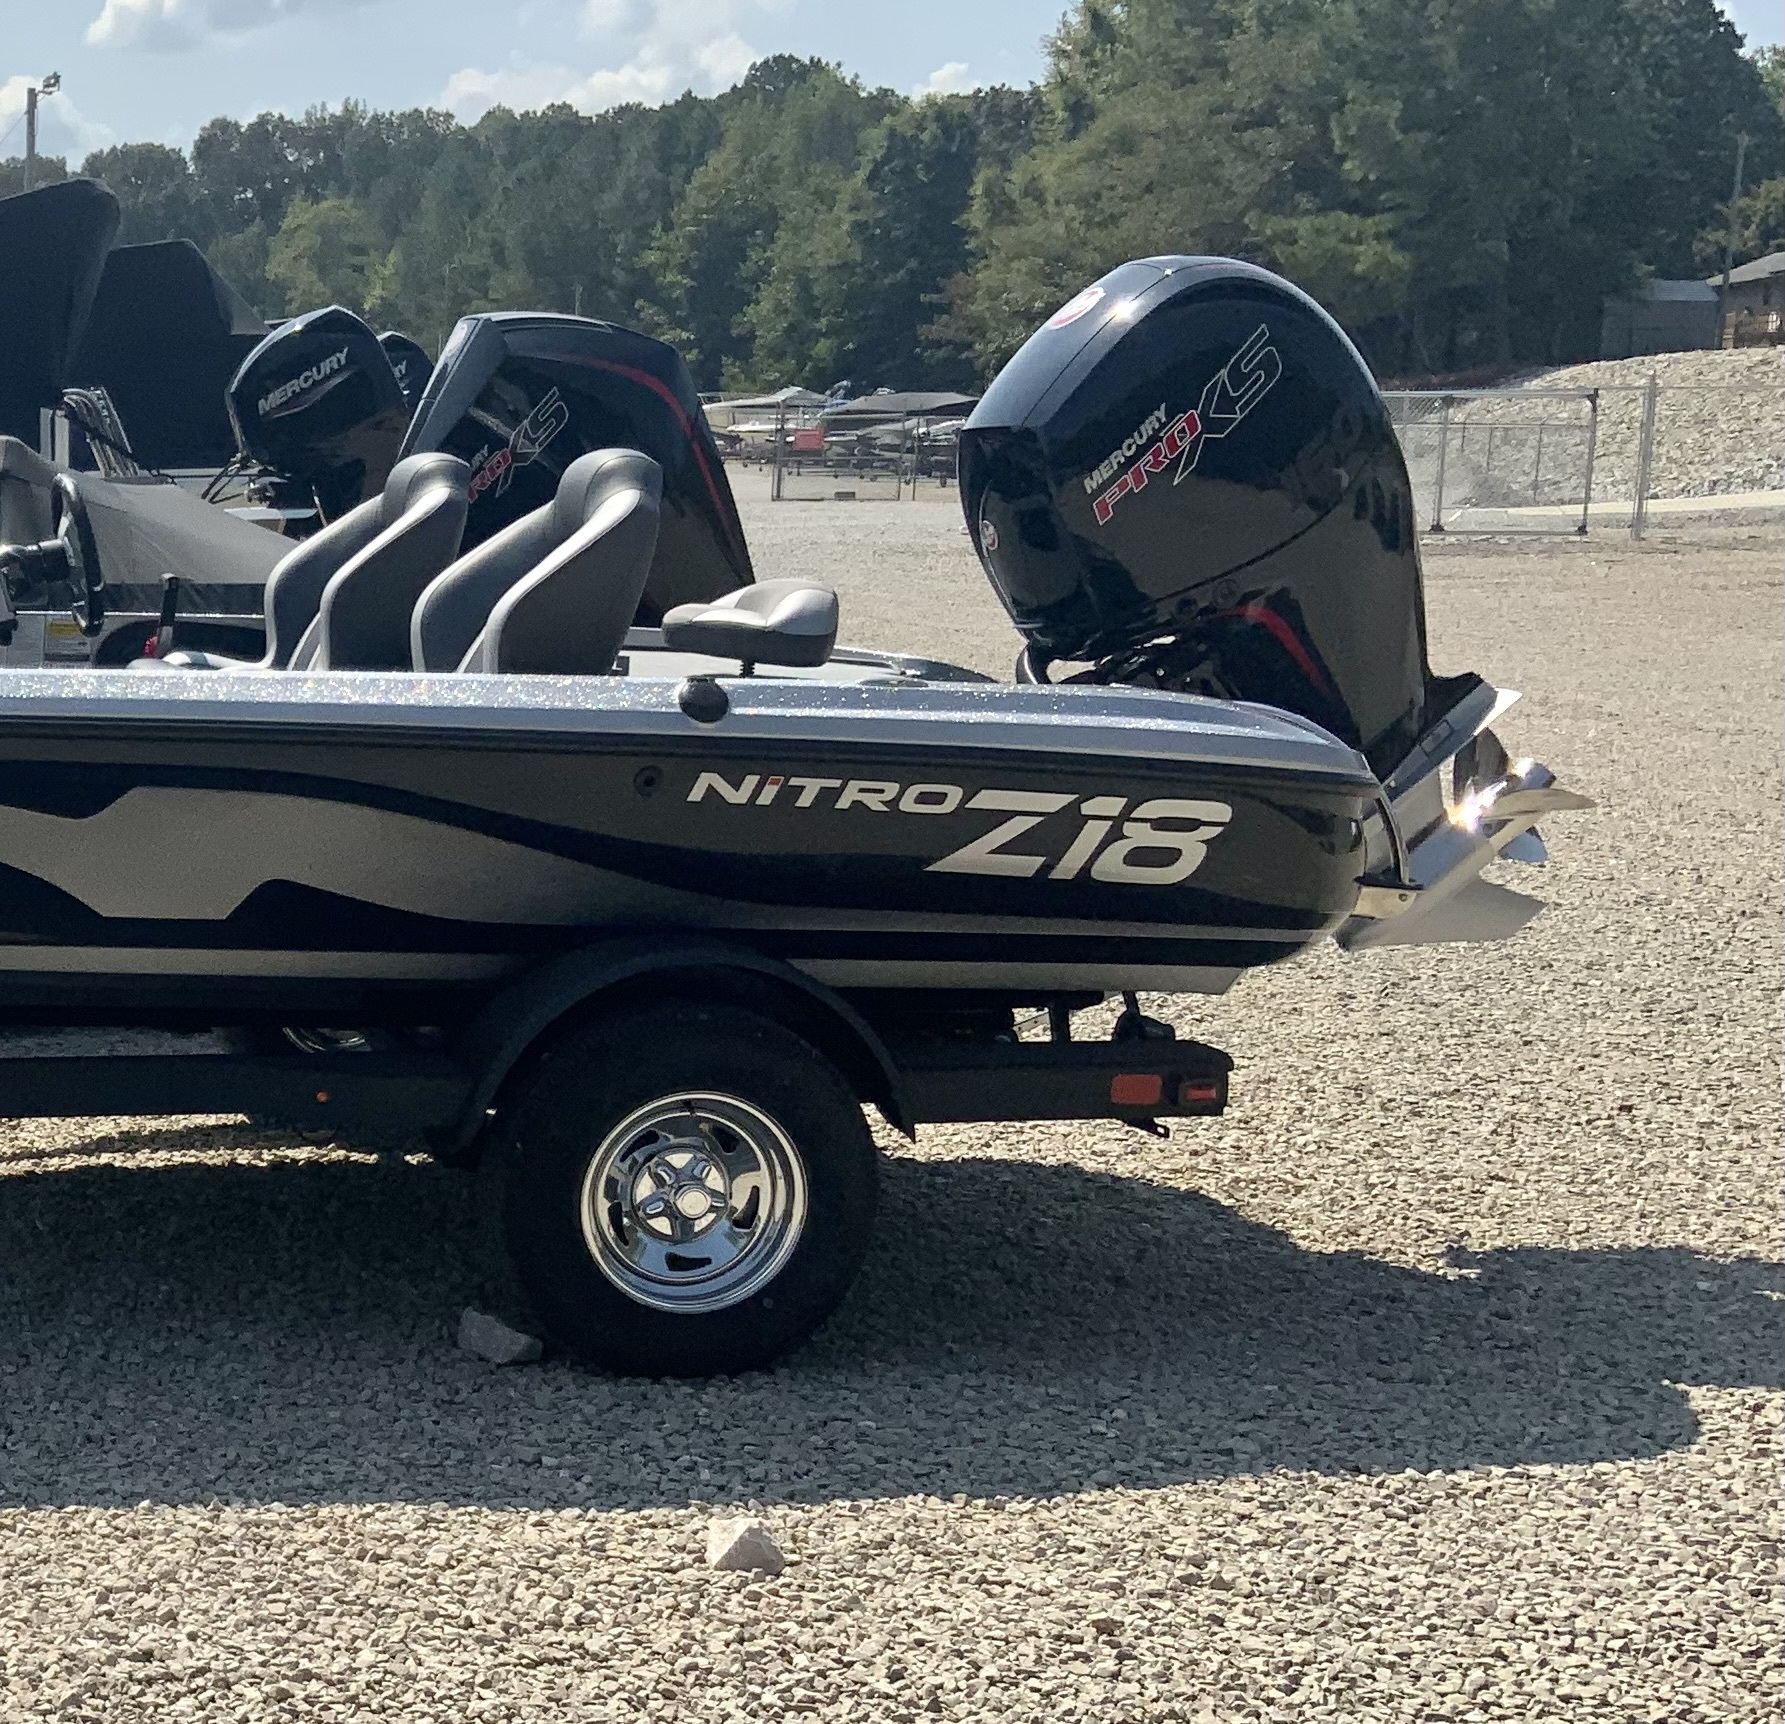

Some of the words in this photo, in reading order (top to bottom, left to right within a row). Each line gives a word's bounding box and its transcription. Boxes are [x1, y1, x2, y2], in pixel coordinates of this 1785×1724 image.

[258, 347, 349, 416] MERCURY
[1093, 409, 1202, 526] PRO
[1159, 323, 1282, 486] XS
[468, 448, 511, 504] RO
[1083, 402, 1166, 494] MERCURY
[922, 789, 1233, 885] Z18
